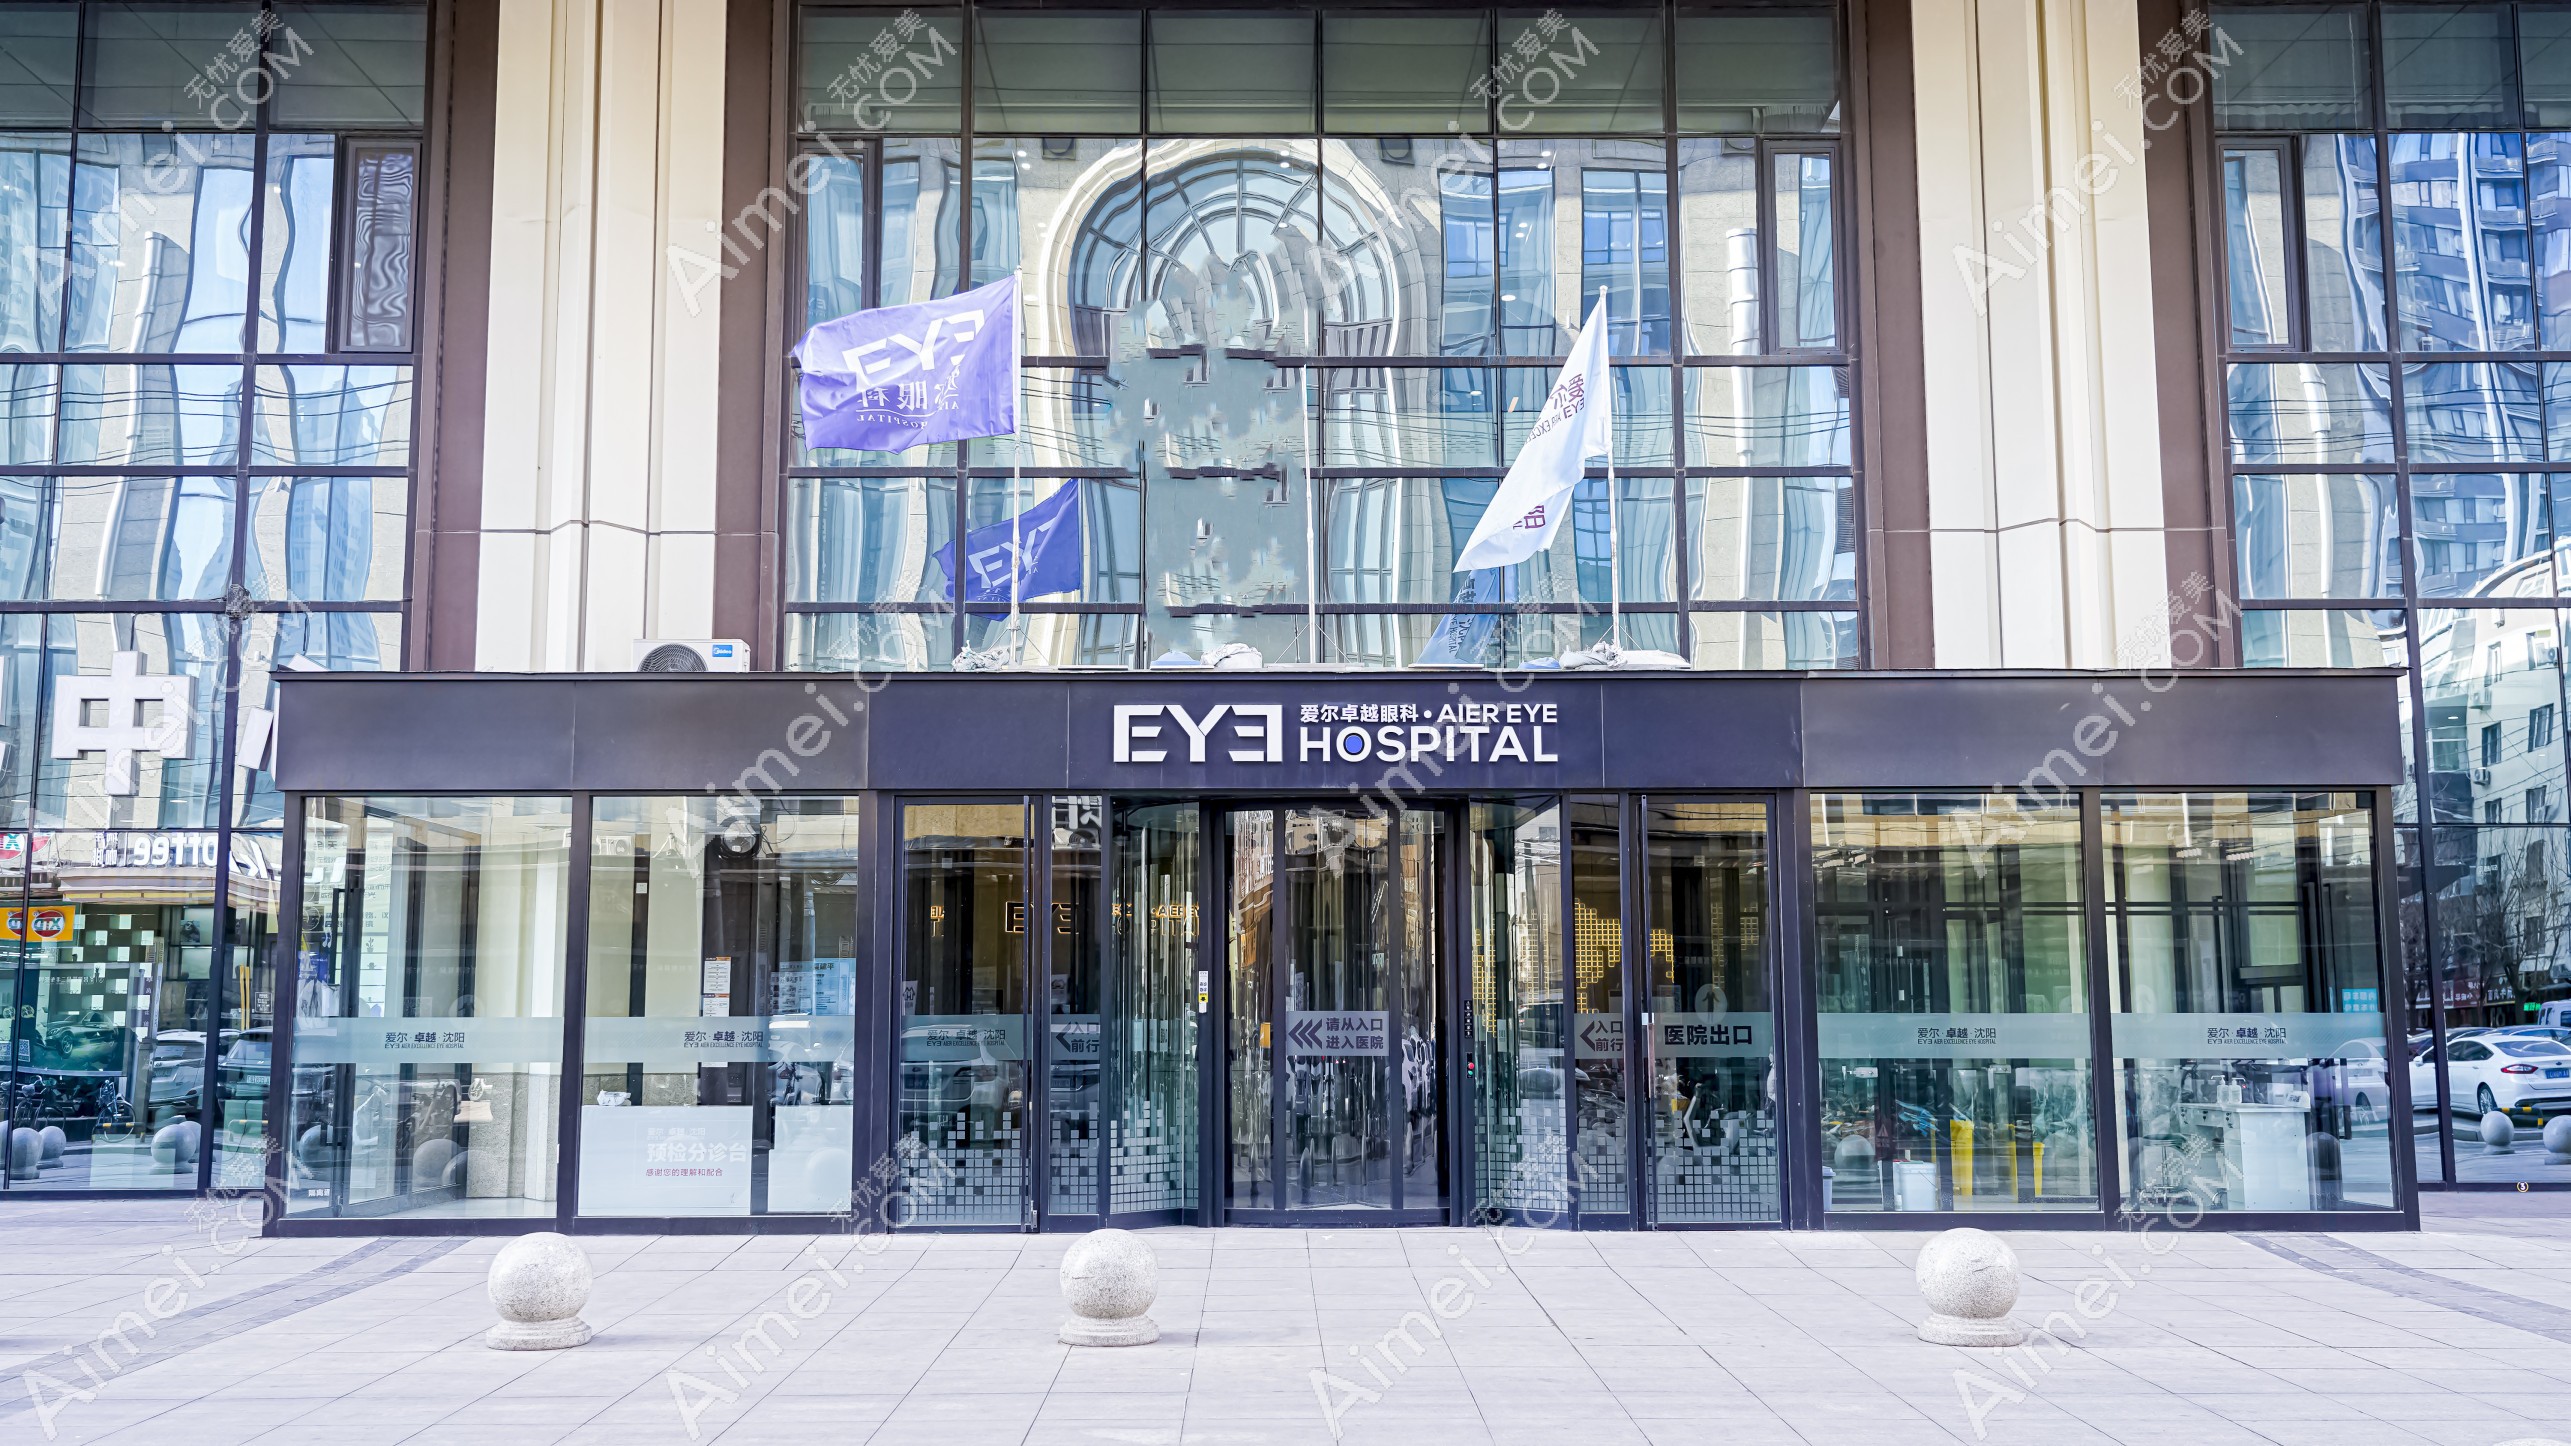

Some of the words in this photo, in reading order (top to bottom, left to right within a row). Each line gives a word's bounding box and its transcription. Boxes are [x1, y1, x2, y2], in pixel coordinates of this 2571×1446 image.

[1300, 704, 1419, 723] 爱尔卓越眼科
[1437, 703, 1500, 723] AIER
[1510, 703, 1558, 723] EYE
[1113, 704, 1283, 762] EYE
[1300, 725, 1559, 763] HOSPITAL
[1325, 1017, 1383, 1032] 请从入口
[1325, 1035, 1384, 1050] 进入医院
[1664, 1024, 1753, 1046] 医院出口
[647, 1142, 748, 1163] 预检分诊台
[646, 1168, 723, 1177] 感谢您的理解和配合
